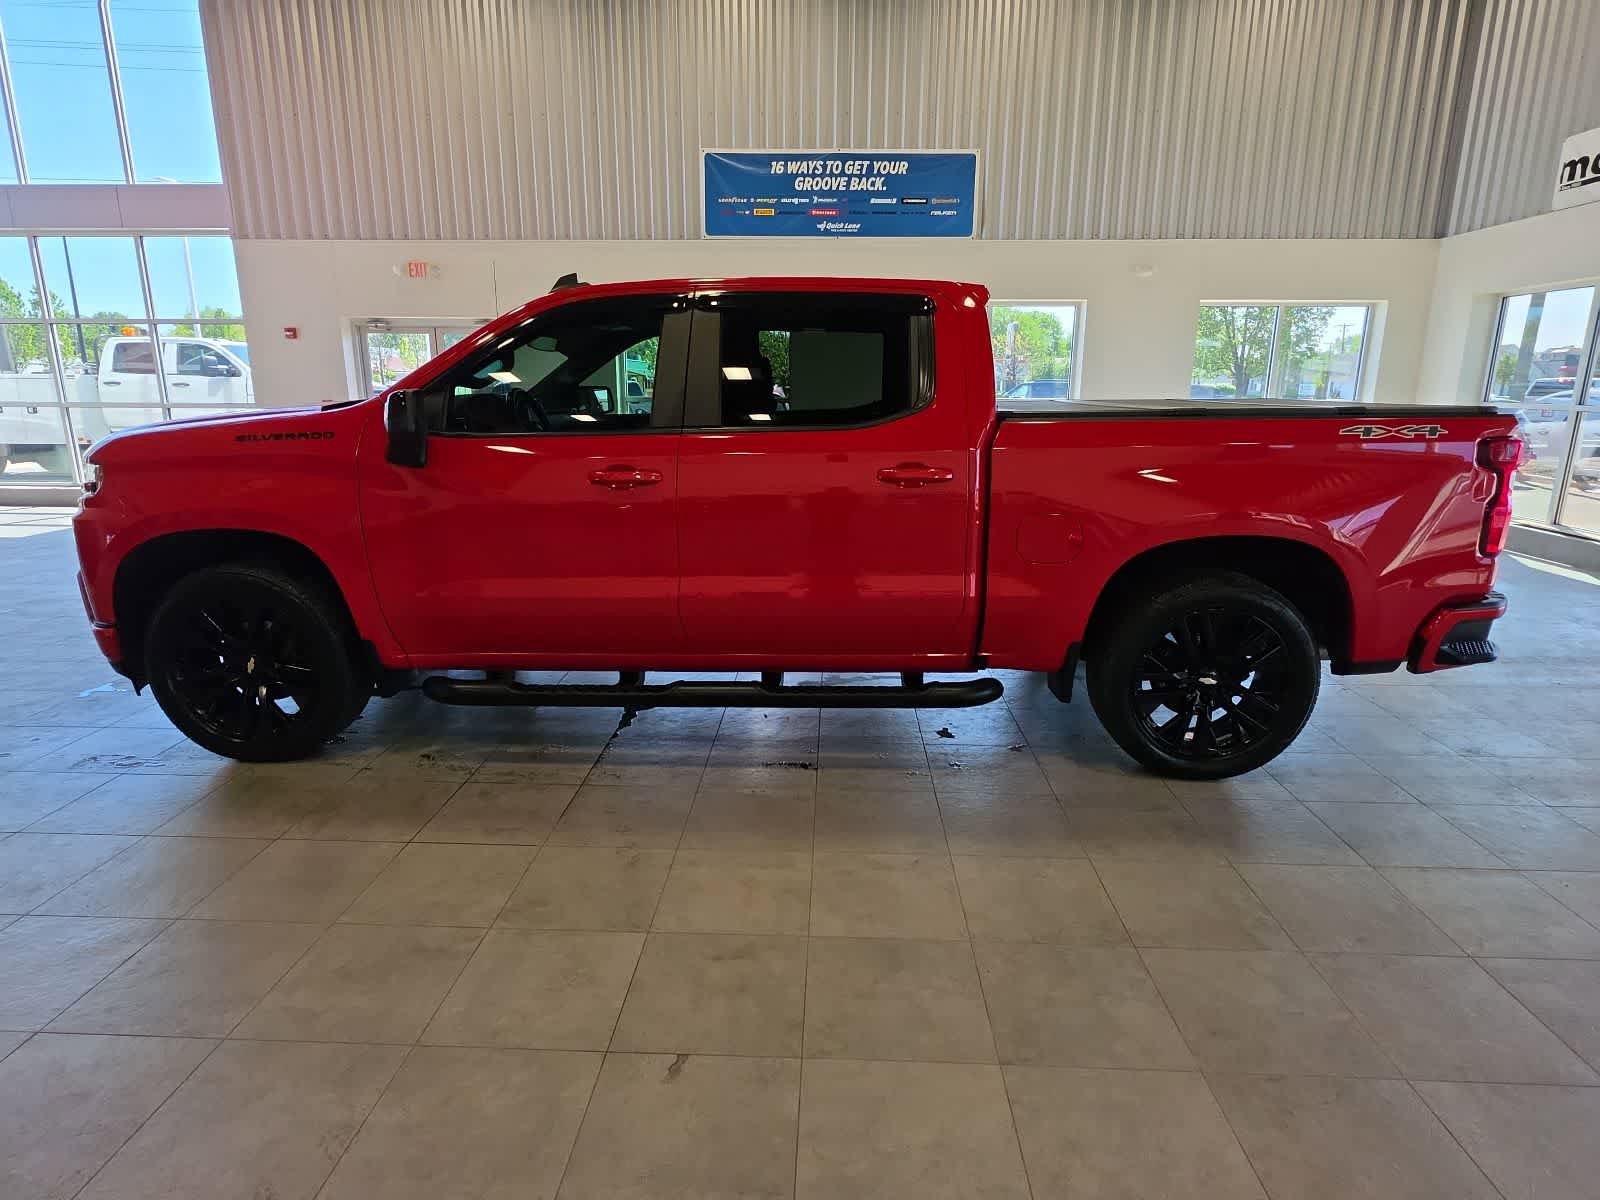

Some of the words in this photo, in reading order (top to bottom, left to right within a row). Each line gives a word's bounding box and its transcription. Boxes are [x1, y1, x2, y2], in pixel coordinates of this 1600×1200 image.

[770, 161, 784, 174] 16
[787, 161, 823, 174] WAYS
[826, 161, 842, 174] TO
[845, 161, 870, 175] GET
[873, 161, 909, 175] YOUR
[794, 177, 848, 191] GROOVE
[849, 177, 887, 191] BACK.
[408, 262, 427, 278] EXIT
[235, 431, 336, 442] SILVERADO
